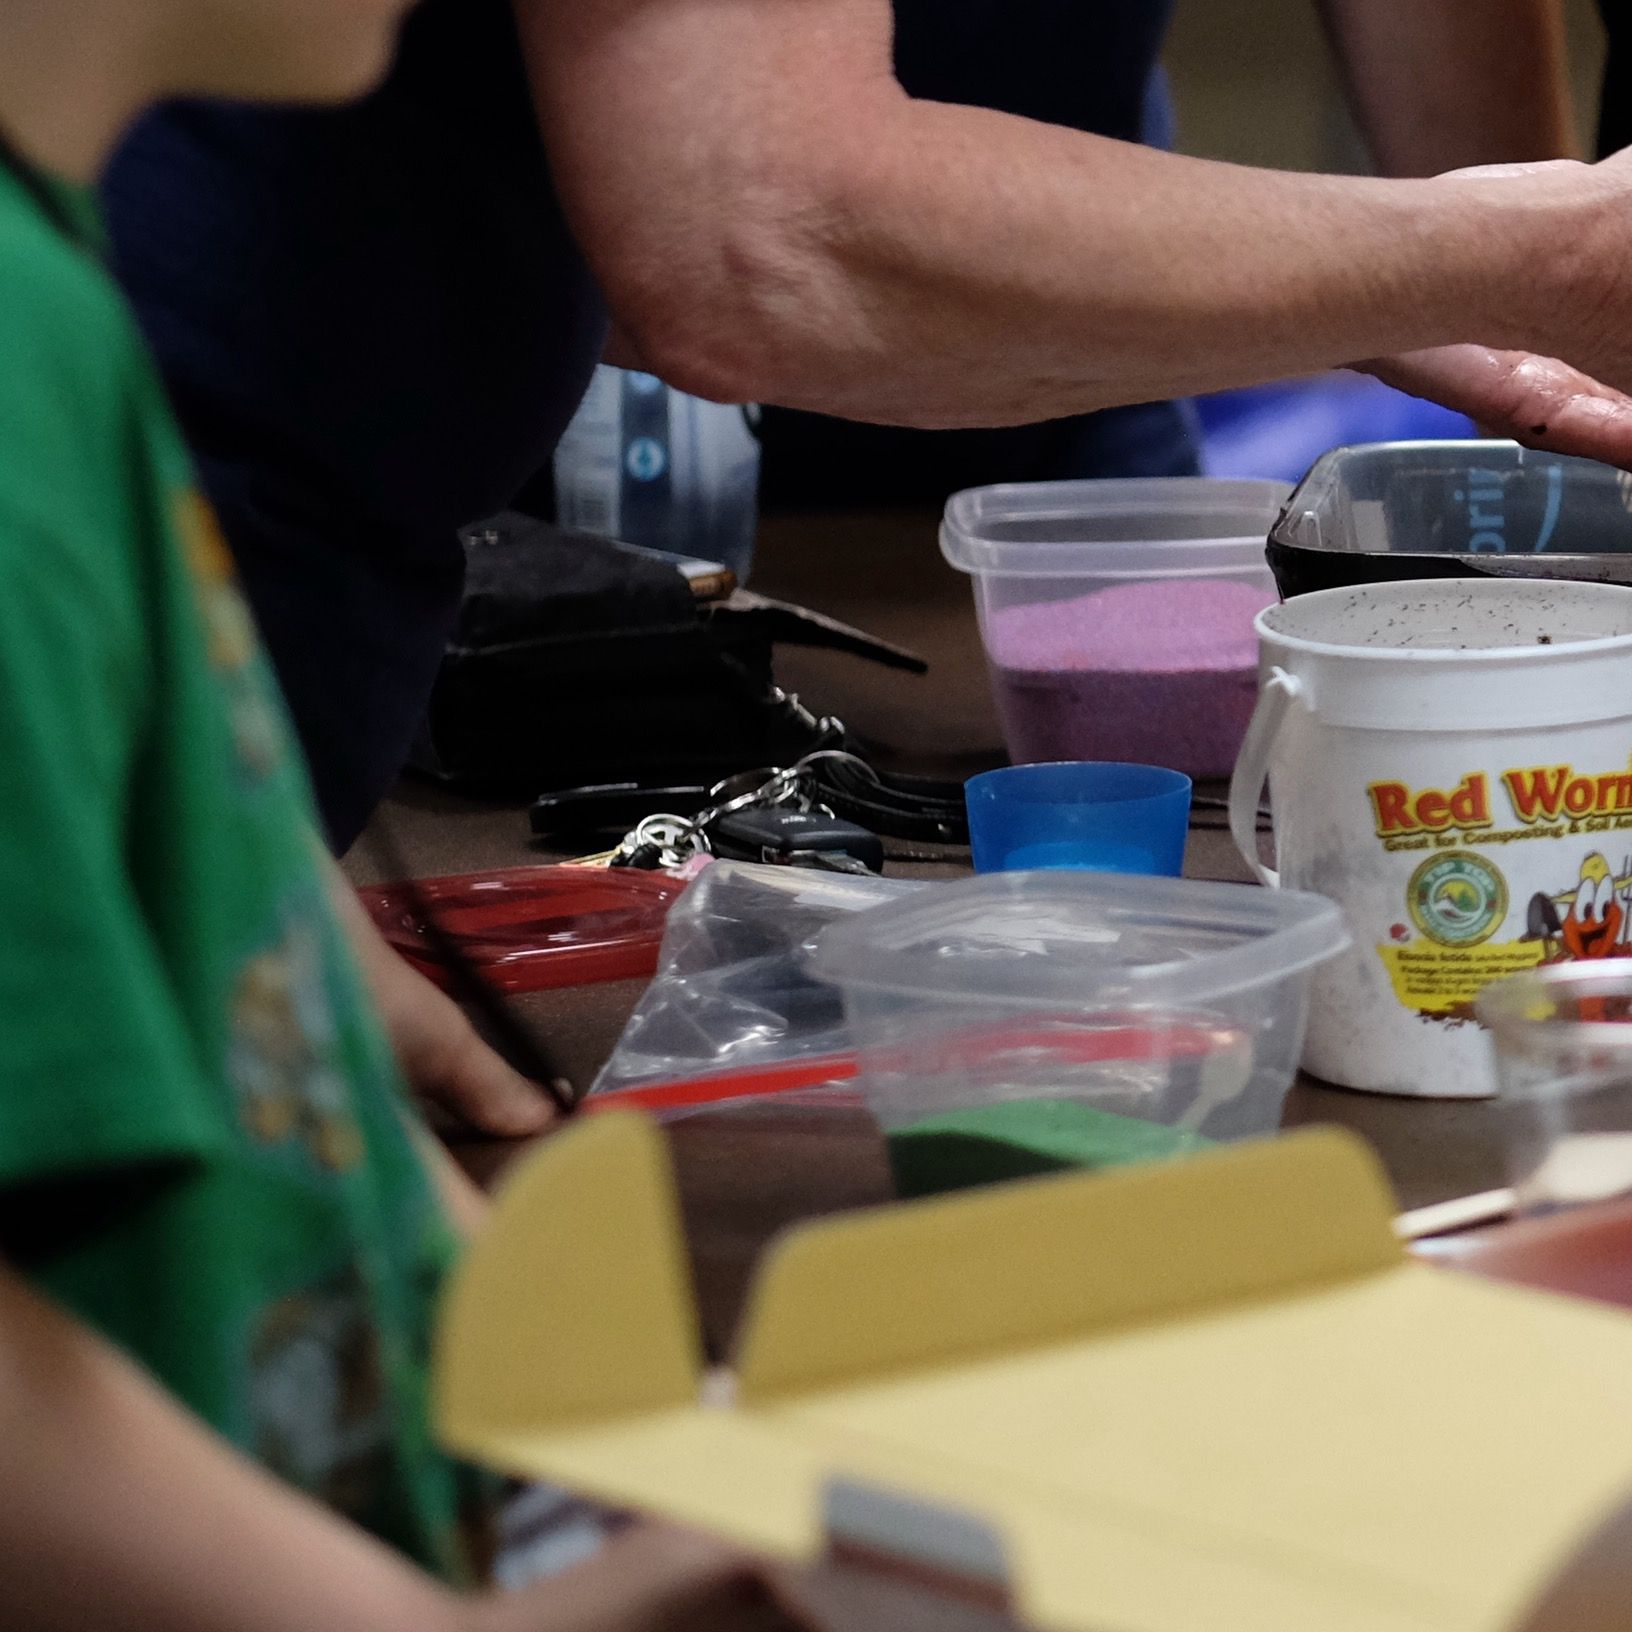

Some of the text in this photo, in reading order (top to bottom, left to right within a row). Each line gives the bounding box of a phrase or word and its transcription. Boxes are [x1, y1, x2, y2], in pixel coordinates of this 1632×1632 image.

[1371, 772, 1490, 832] Red
[1463, 822, 1564, 845] Composting
[1568, 822, 1580, 834] &
